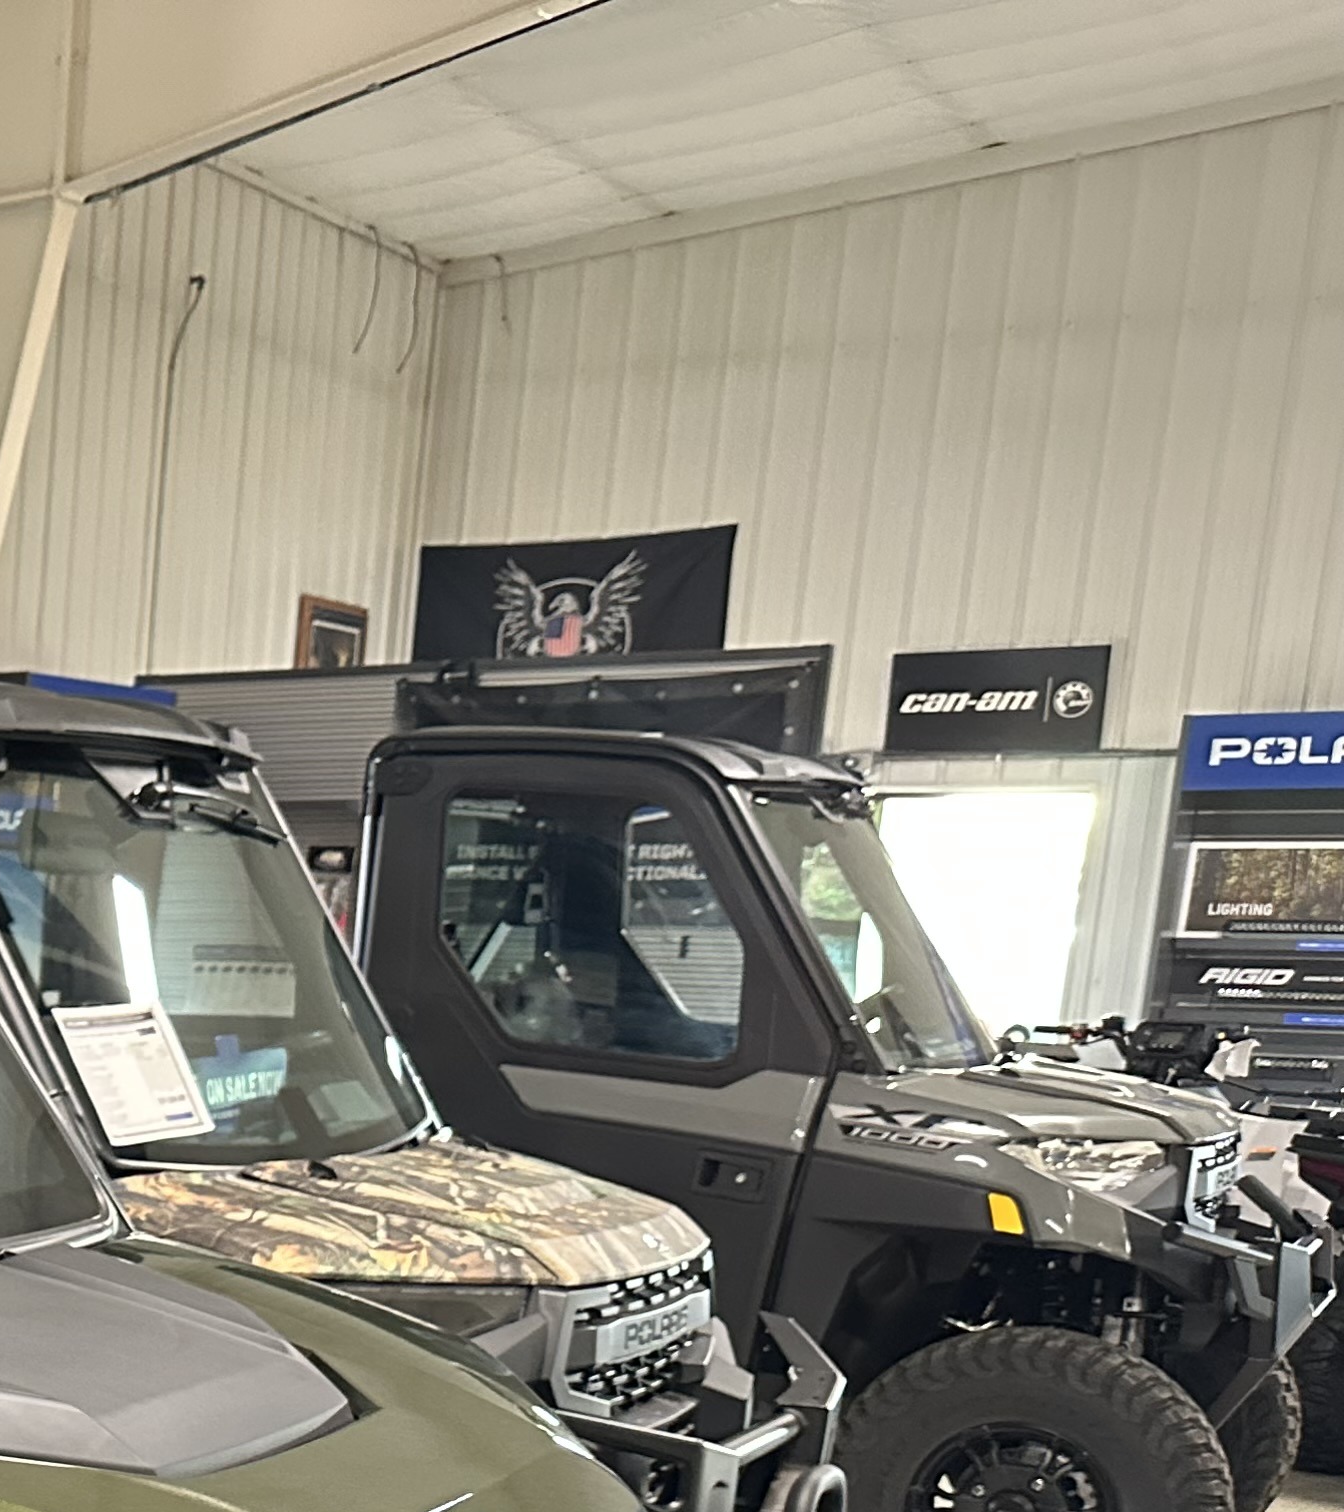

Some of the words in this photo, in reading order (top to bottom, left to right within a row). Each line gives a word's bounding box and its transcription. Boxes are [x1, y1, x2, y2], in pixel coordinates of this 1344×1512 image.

[900, 689, 1038, 714] can-am
[1208, 903, 1273, 916] LIGHTING
[1198, 967, 1296, 985] RIGID
[226, 1071, 257, 1099] SALE
[851, 1127, 949, 1150] 1000
